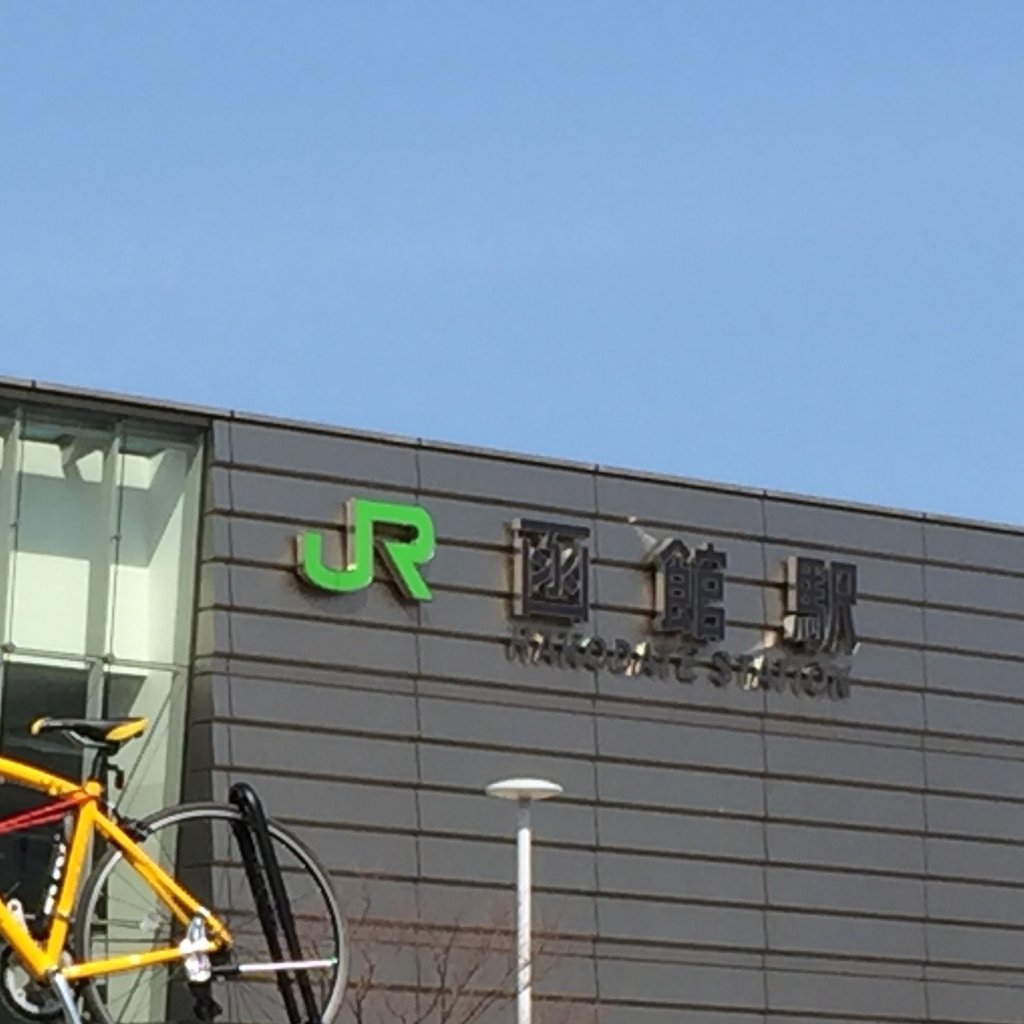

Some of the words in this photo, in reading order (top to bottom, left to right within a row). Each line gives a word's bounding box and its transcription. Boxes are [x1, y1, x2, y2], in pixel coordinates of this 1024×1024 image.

[297, 497, 436, 601] JR
[510, 517, 859, 656] 函館駅
